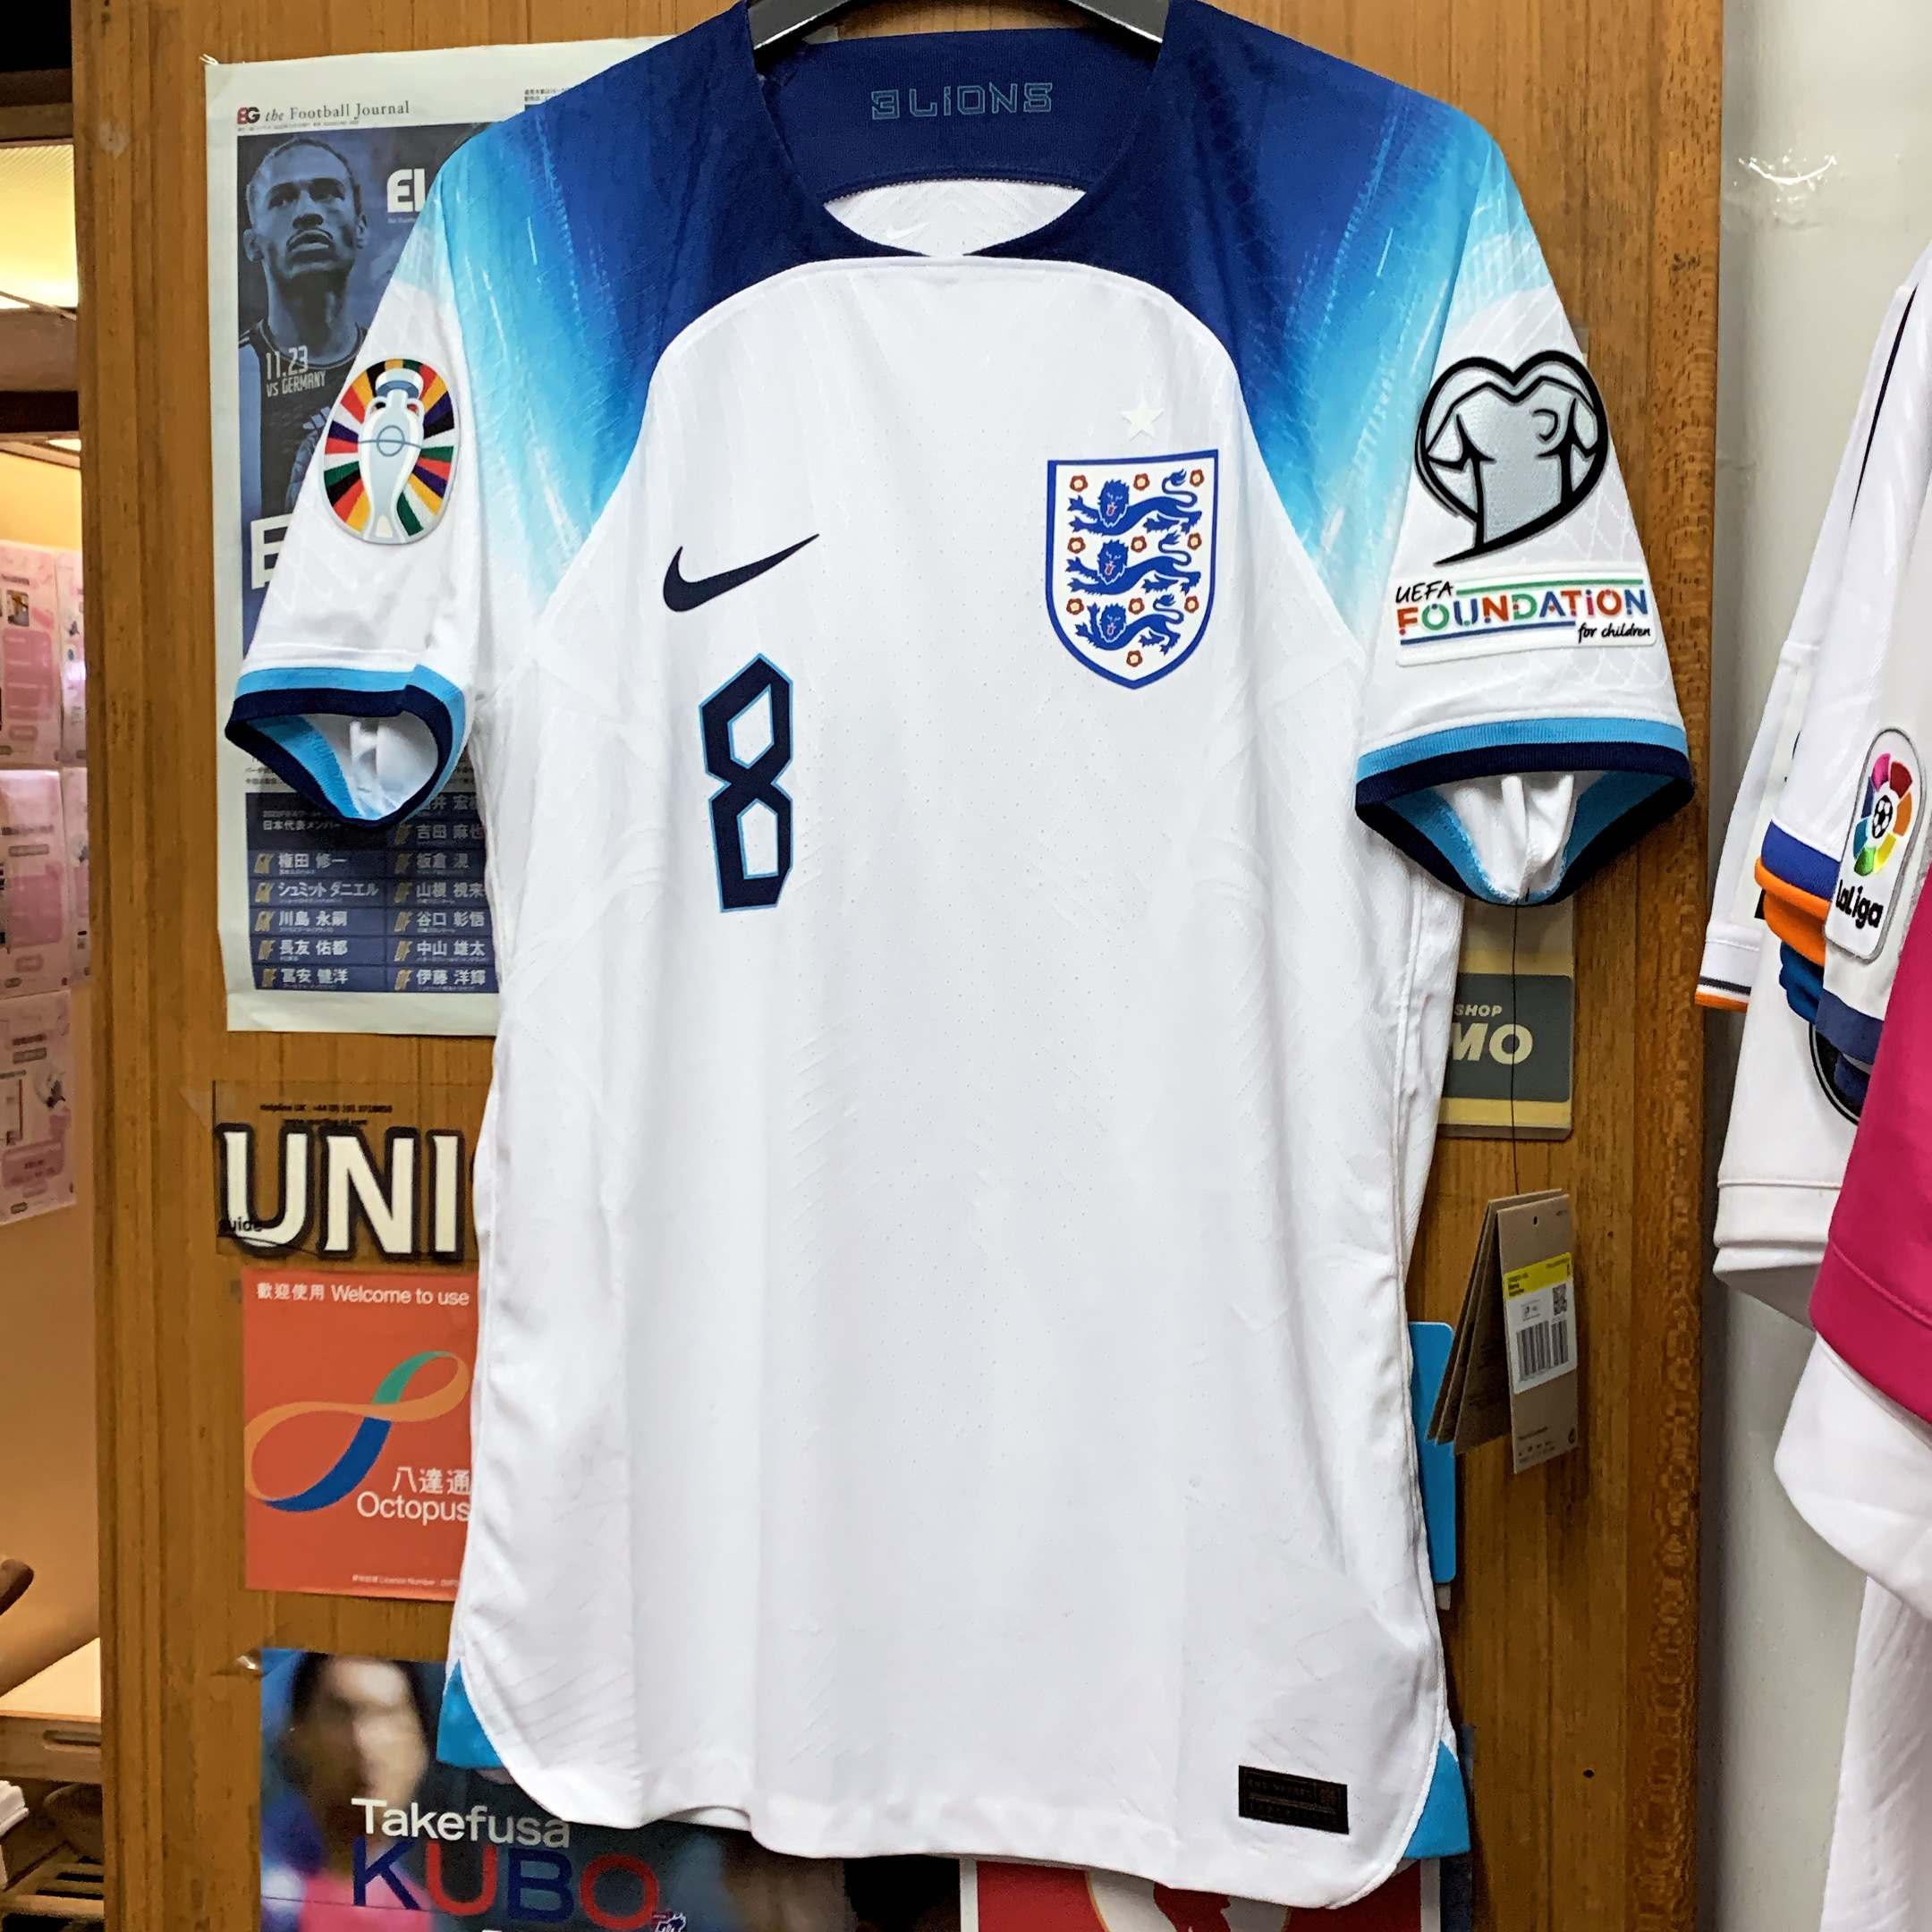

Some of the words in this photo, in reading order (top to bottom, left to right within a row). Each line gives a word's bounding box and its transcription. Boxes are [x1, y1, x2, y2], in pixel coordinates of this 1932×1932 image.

[265, 108, 284, 123] the
[290, 103, 352, 120] Football
[353, 100, 410, 120] Journal
[870, 89, 900, 120] 3
[266, 345, 309, 380] 11.23
[281, 369, 326, 394] GERMANY
[1395, 580, 1454, 604] UEFA
[1578, 624, 1597, 644] for
[1600, 622, 1650, 638] children
[699, 652, 793, 913] 8
[416, 824, 447, 839] 吉田
[330, 881, 380, 897] ダニエル
[278, 911, 310, 926] 川島
[416, 911, 447, 927] 谷口
[279, 940, 310, 955] 長友
[417, 940, 447, 956] 中山
[453, 940, 486, 956] 雄太
[1454, 1004, 1503, 1017] SHOP
[218, 1125, 467, 1261] UNI
[257, 1282, 325, 1301] 歡迎使用
[330, 1284, 412, 1303] Welcome
[415, 1287, 434, 1305] to
[437, 1291, 470, 1306] use
[392, 1465, 471, 1496] 八達通
[357, 1491, 472, 1526] Octopus
[351, 1797, 571, 1849] Takefusa
[352, 1835, 660, 1931] KUBO
